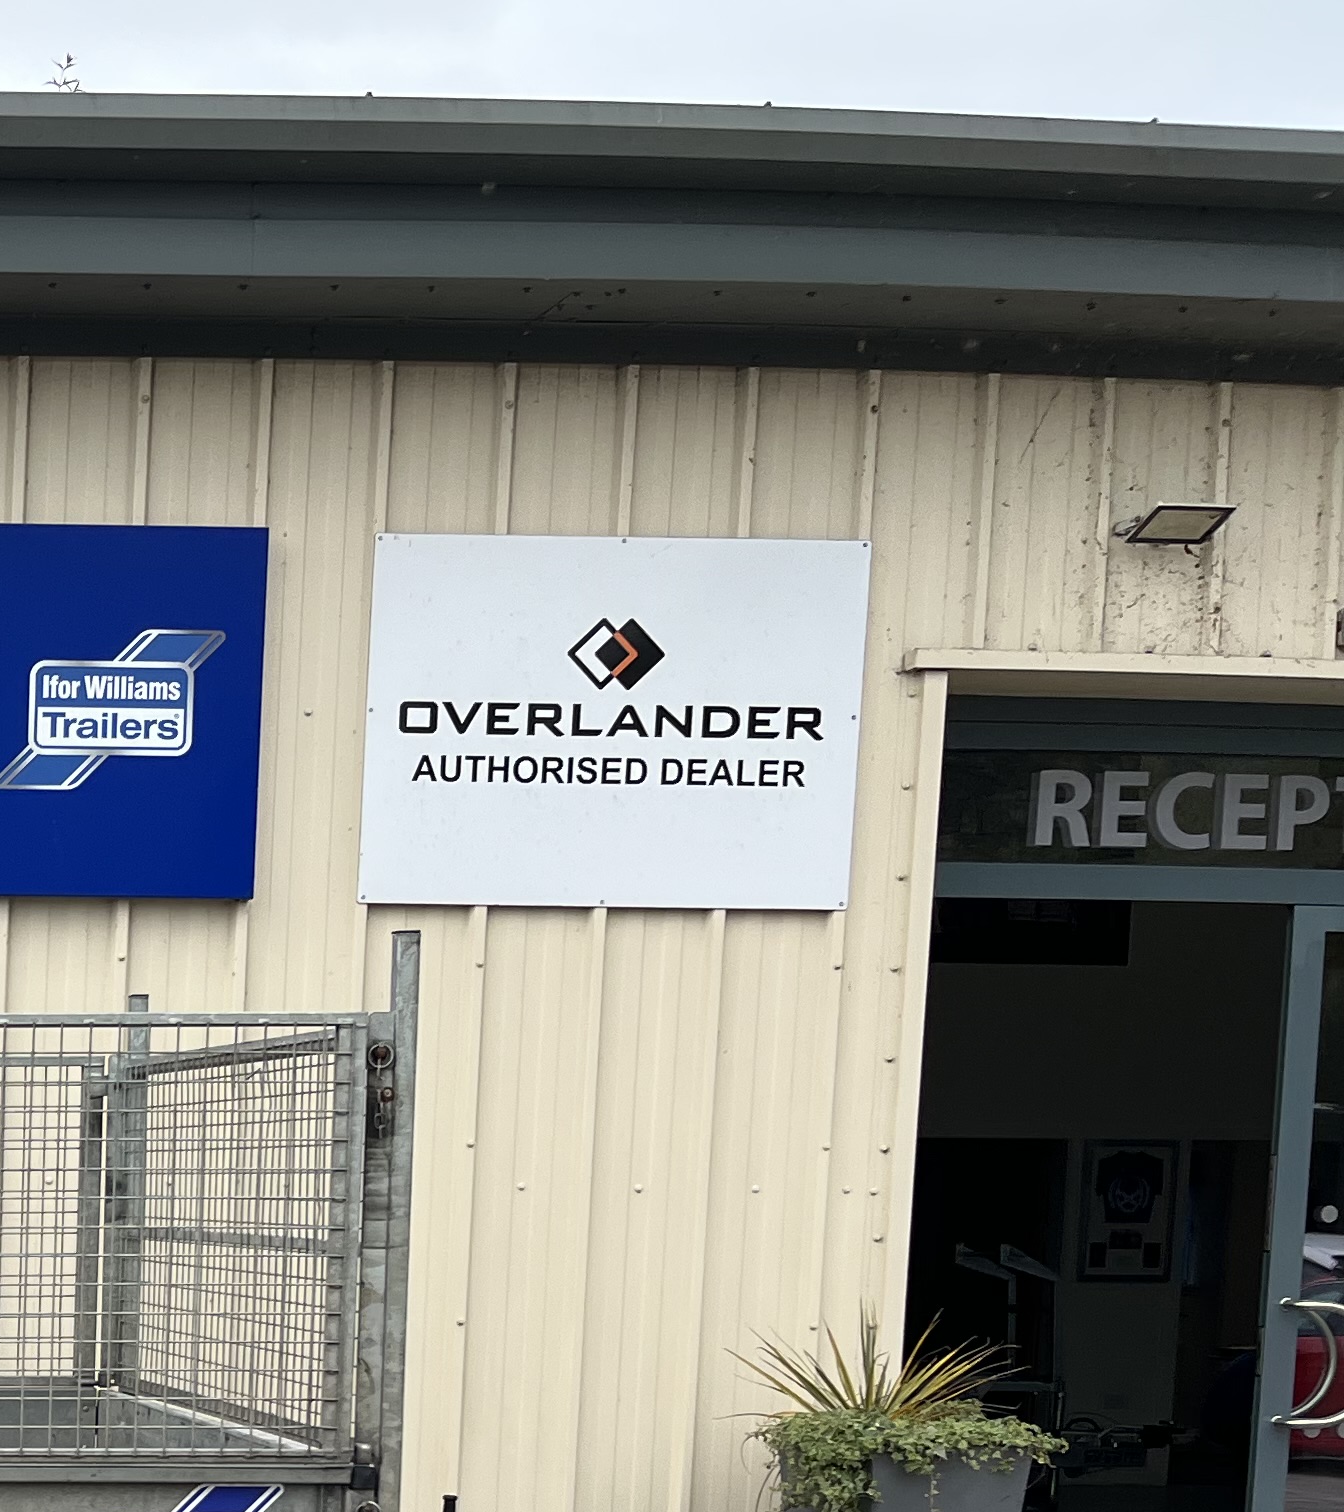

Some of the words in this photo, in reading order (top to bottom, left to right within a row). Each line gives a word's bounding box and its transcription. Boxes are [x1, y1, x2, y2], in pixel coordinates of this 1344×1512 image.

[43, 675, 80, 698] Ifor
[84, 676, 180, 700] Williams
[42, 711, 178, 740] Trailers
[399, 701, 823, 740] OVERLANDER
[412, 755, 647, 784] AUTHORISED
[661, 759, 804, 787] DEALER
[1029, 769, 1344, 851] RECEP
